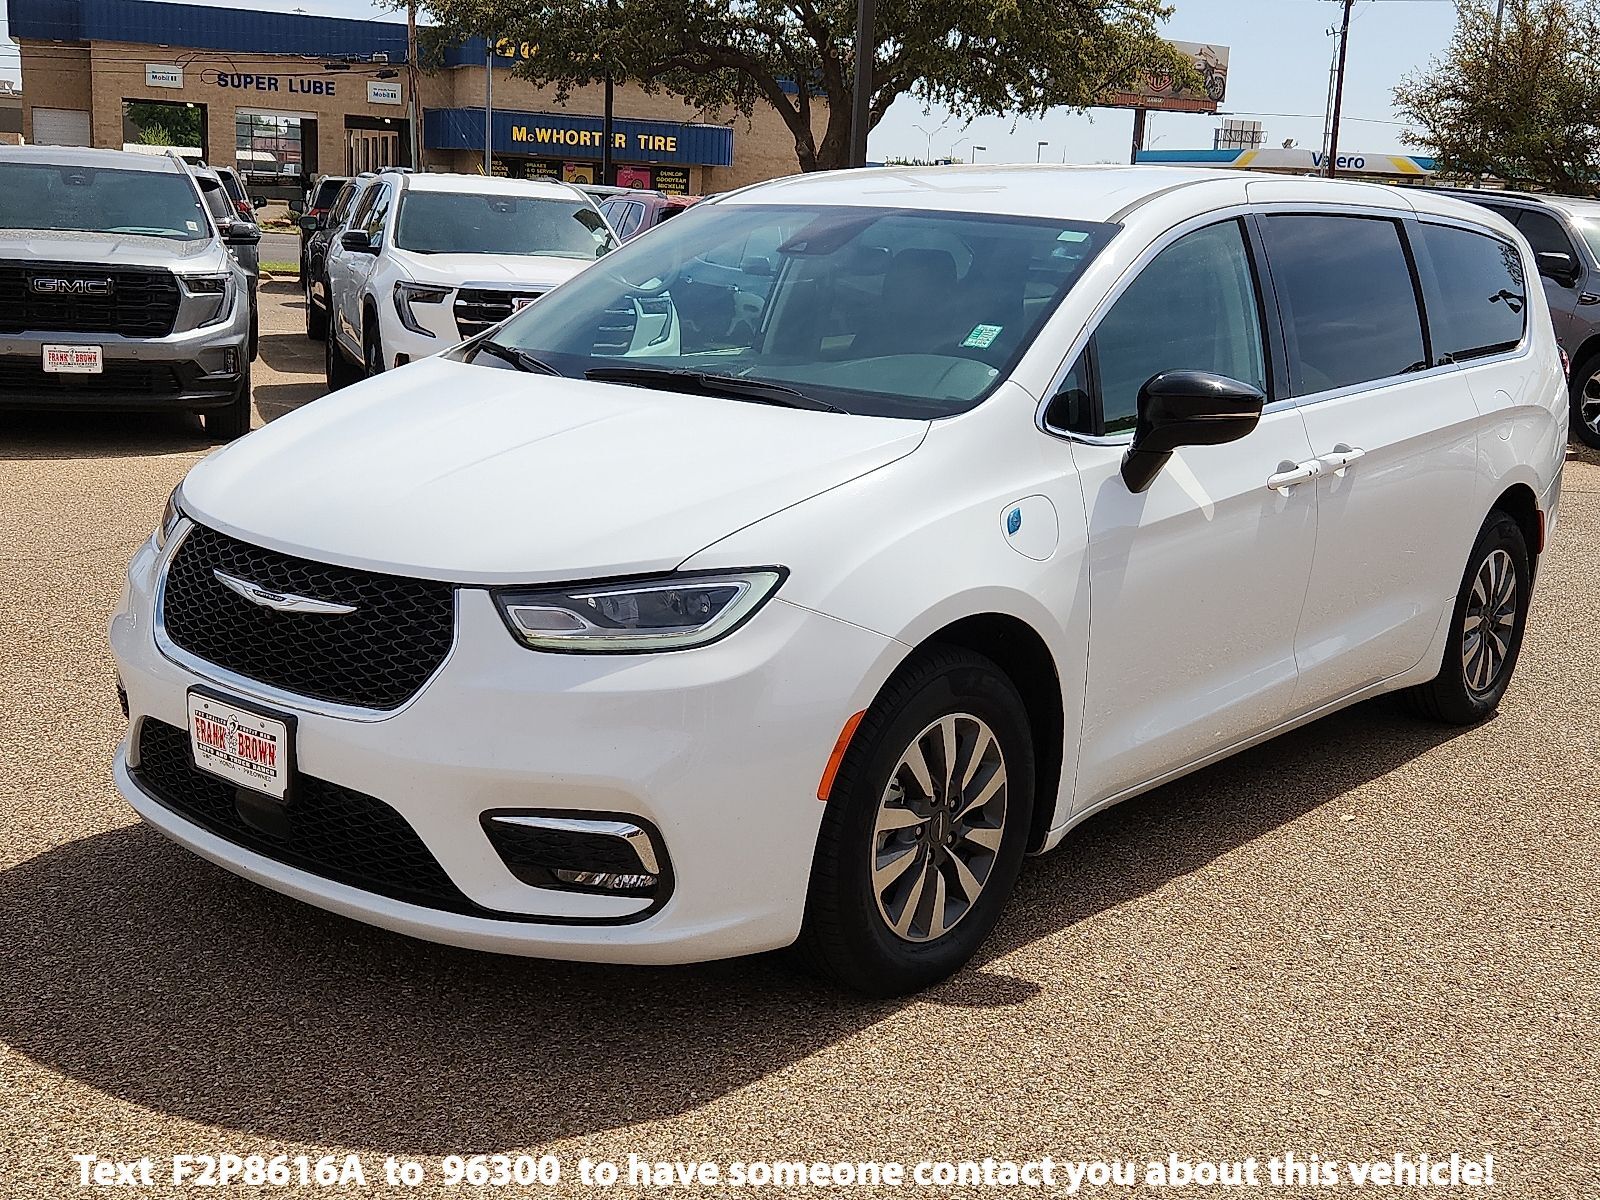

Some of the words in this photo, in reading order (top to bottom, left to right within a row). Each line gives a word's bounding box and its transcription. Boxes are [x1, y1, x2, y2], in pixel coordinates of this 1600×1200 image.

[217, 73, 279, 92] SUPER
[288, 78, 336, 96] LUBE
[637, 134, 677, 152] TIRE
[1311, 151, 1366, 169] Vaero
[34, 278, 107, 294] GMC
[48, 353, 69, 362] FRANK
[75, 353, 97, 363] BROWN
[195, 717, 227, 751] FRANK
[238, 732, 277, 768] BROWN
[199, 743, 214, 754] AUTO
[215, 750, 228, 760] AND
[229, 755, 251, 768] TRUCK
[251, 762, 275, 776] RANCH
